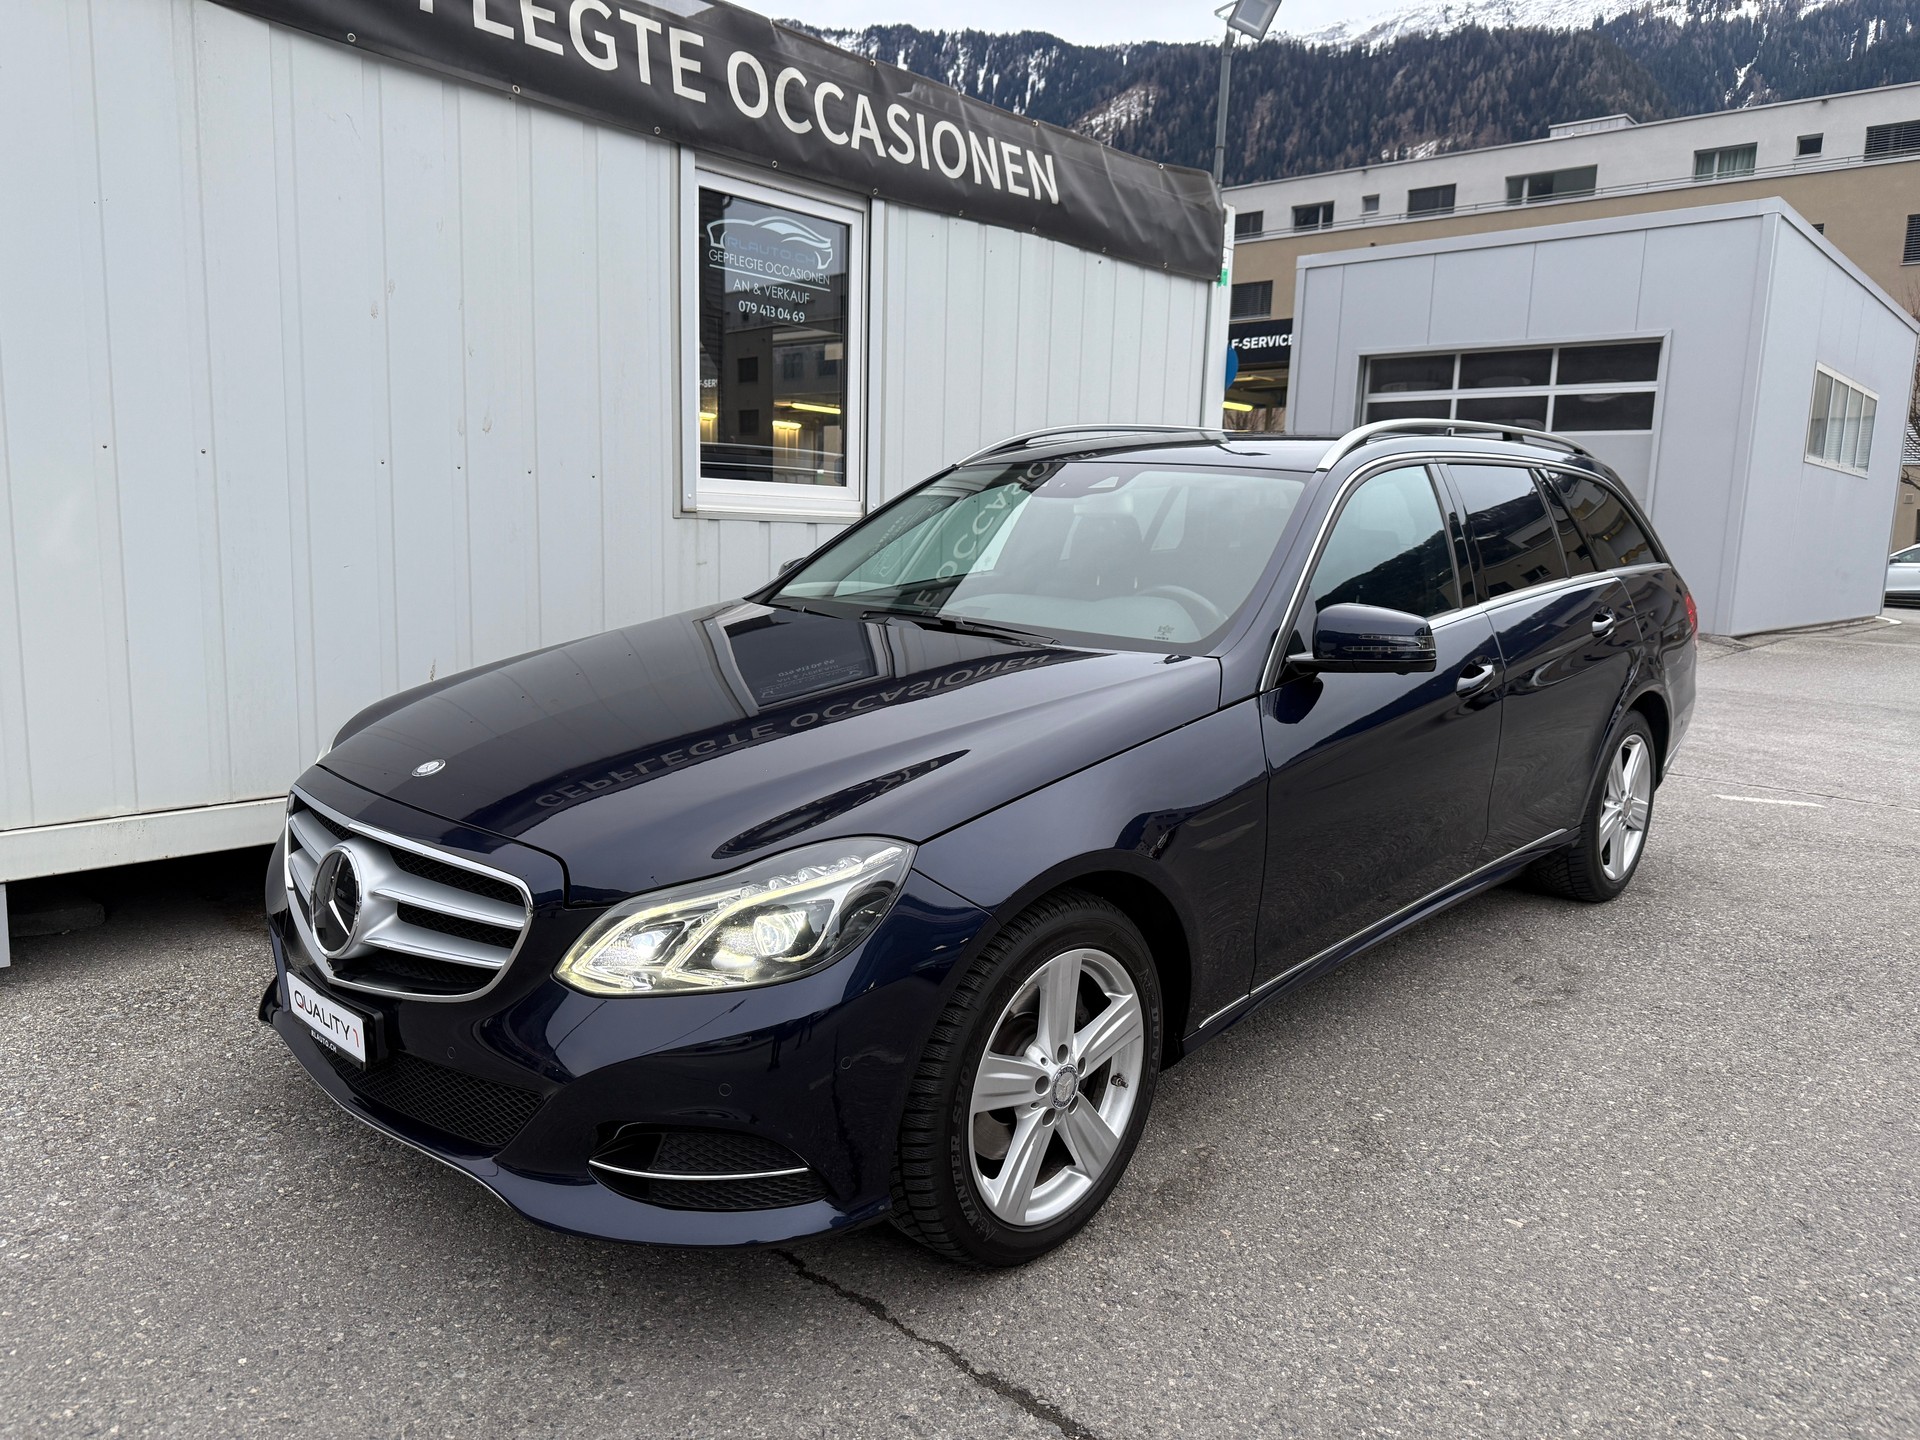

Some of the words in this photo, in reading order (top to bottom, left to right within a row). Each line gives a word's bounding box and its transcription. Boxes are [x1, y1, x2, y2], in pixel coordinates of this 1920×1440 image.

[420, 0, 706, 103] LEGTE
[727, 50, 1059, 204] OCCASIONEN
[708, 249, 763, 271] GEPFLEGTE
[765, 262, 830, 285] OCCASIONEN
[733, 279, 750, 292] AN
[753, 283, 761, 295] &
[764, 285, 810, 304] VERKAUF
[738, 300, 757, 314] 079
[760, 304, 776, 318] 413
[777, 307, 790, 320] 04
[792, 311, 805, 323] 69
[294, 990, 350, 1040] QUALITY
[353, 1028, 359, 1047] 1
[951, 1135, 979, 1227] WINTER
